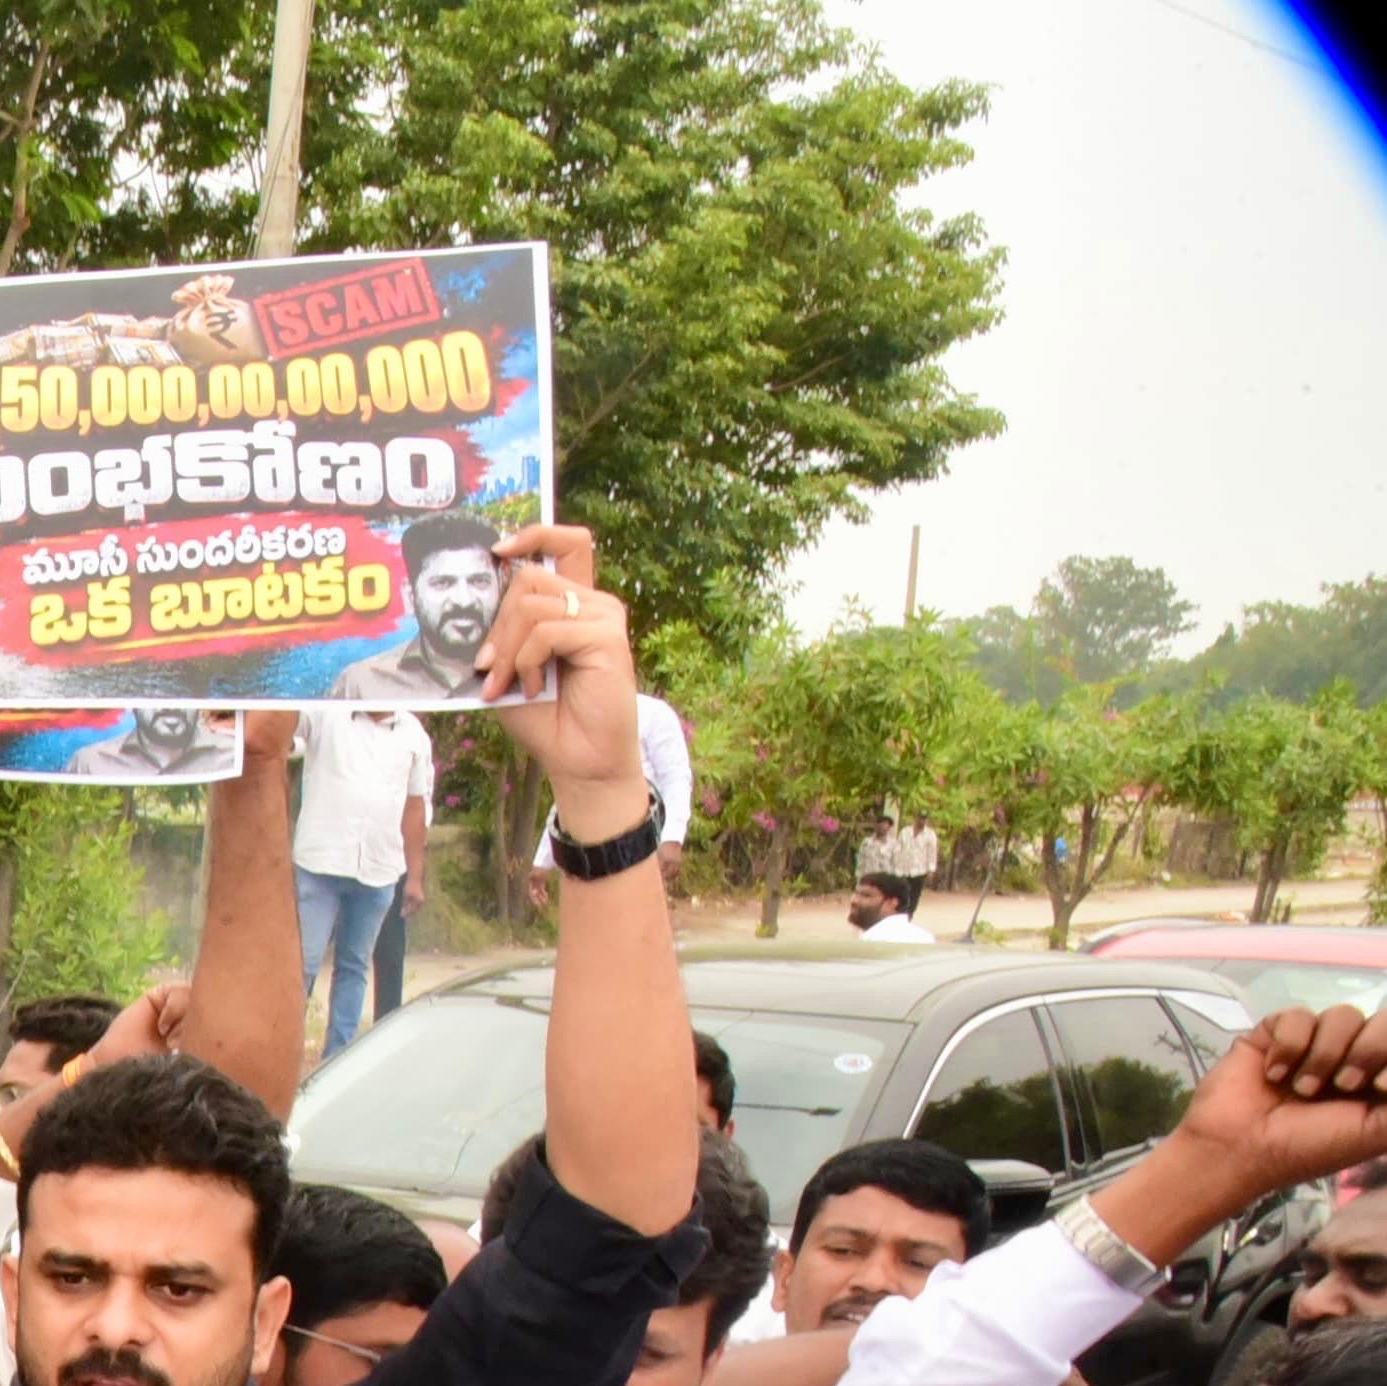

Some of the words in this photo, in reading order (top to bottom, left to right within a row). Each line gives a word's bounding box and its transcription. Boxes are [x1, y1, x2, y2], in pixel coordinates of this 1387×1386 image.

[273, 270, 423, 345] SCAM
[22, 534, 128, 584] మూసీ
[30, 575, 132, 646] ఒక
[150, 556, 390, 632] బూటకం
